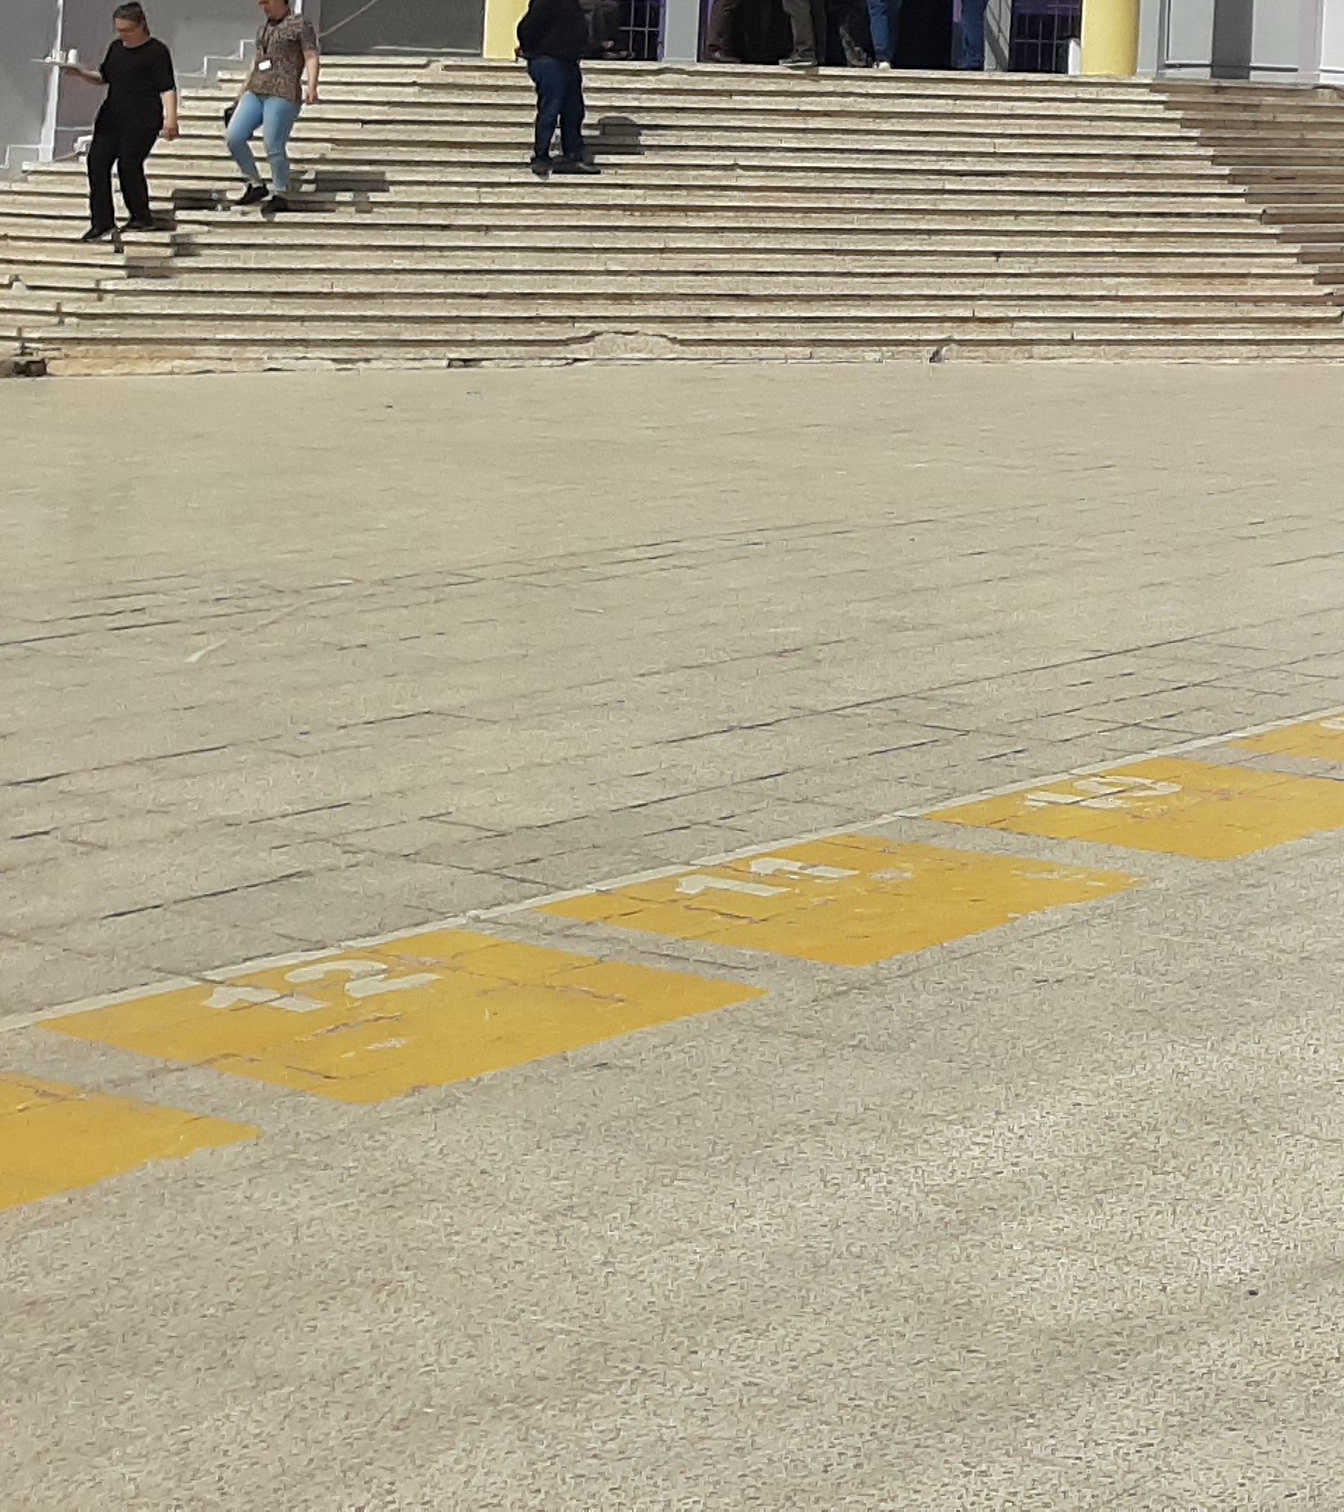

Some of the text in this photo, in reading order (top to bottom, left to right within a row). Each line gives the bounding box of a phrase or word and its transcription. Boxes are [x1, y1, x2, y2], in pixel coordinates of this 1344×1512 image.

[1024, 775, 1184, 811] 10
[675, 857, 862, 898] 11
[202, 958, 445, 1013] 12
